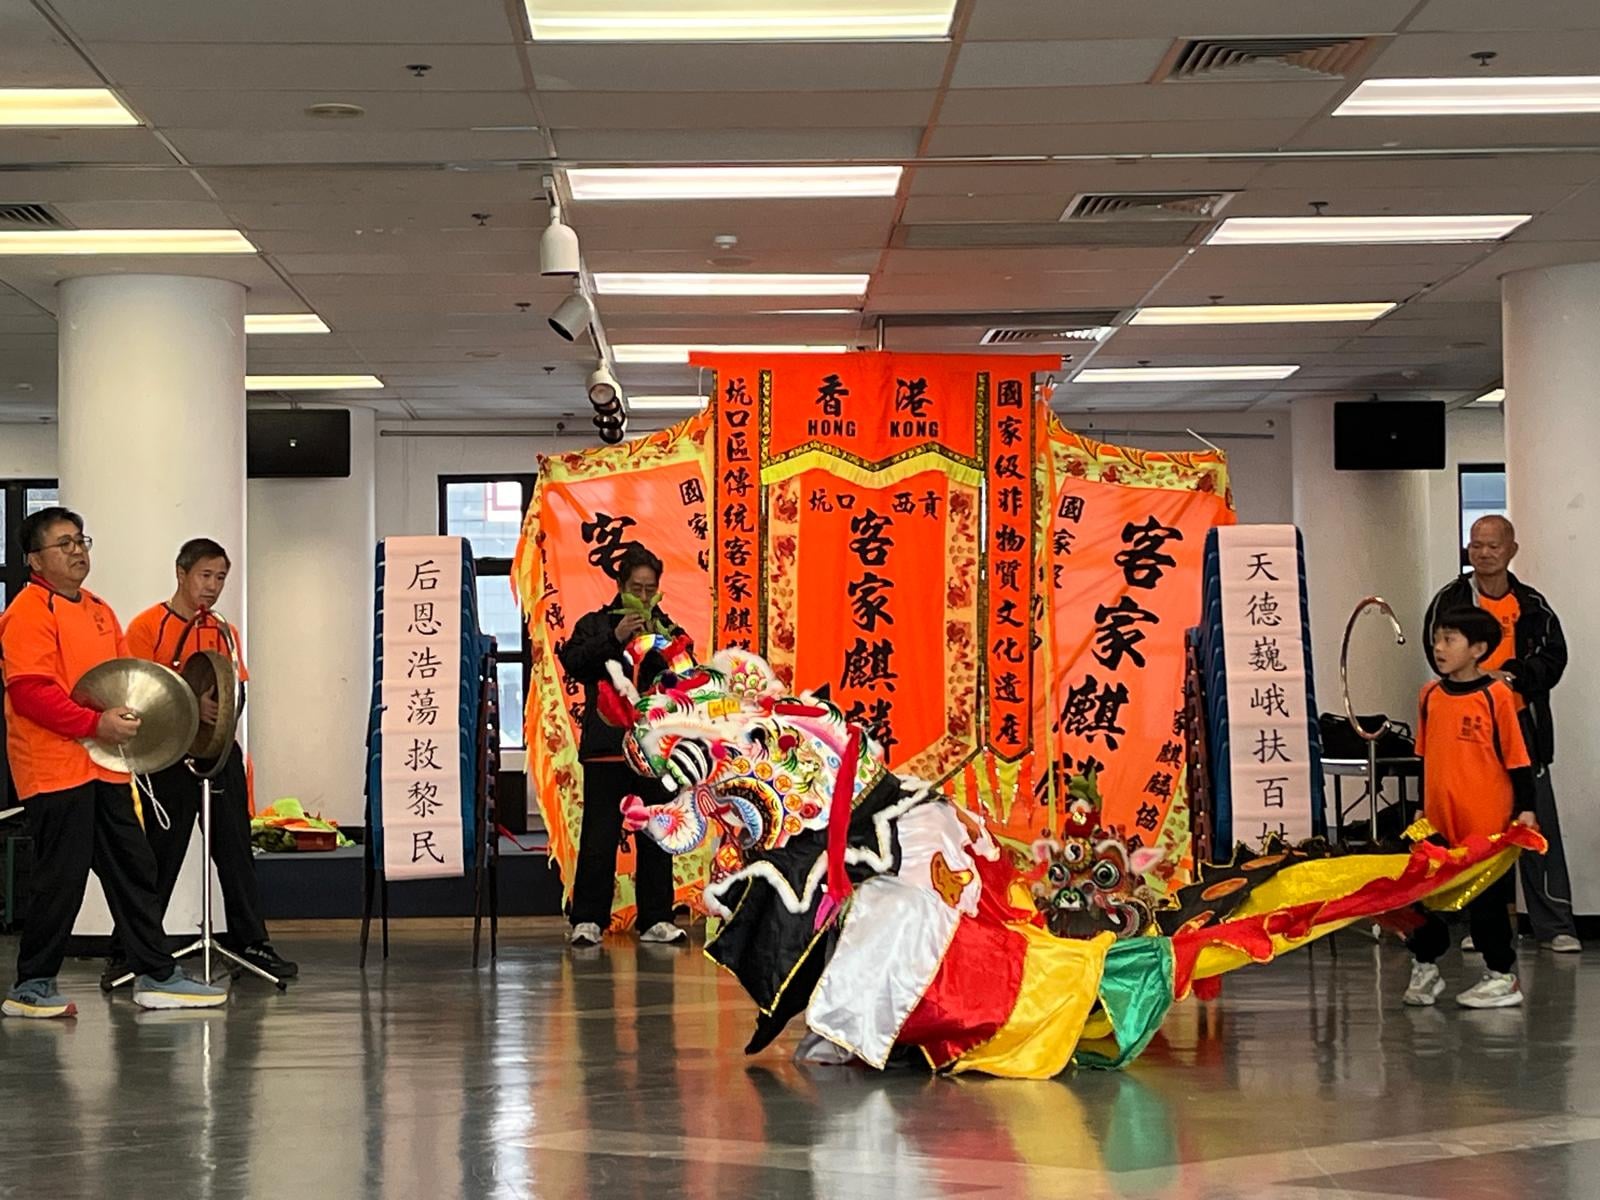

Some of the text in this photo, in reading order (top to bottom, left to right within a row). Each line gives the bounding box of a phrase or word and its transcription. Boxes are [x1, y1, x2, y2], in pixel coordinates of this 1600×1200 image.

[815, 374, 932, 418] 香港
[808, 418, 938, 438] HONG KONG
[809, 489, 942, 520] 坑口 西貢
[404, 559, 445, 864] 后恩浩蕩救黎民
